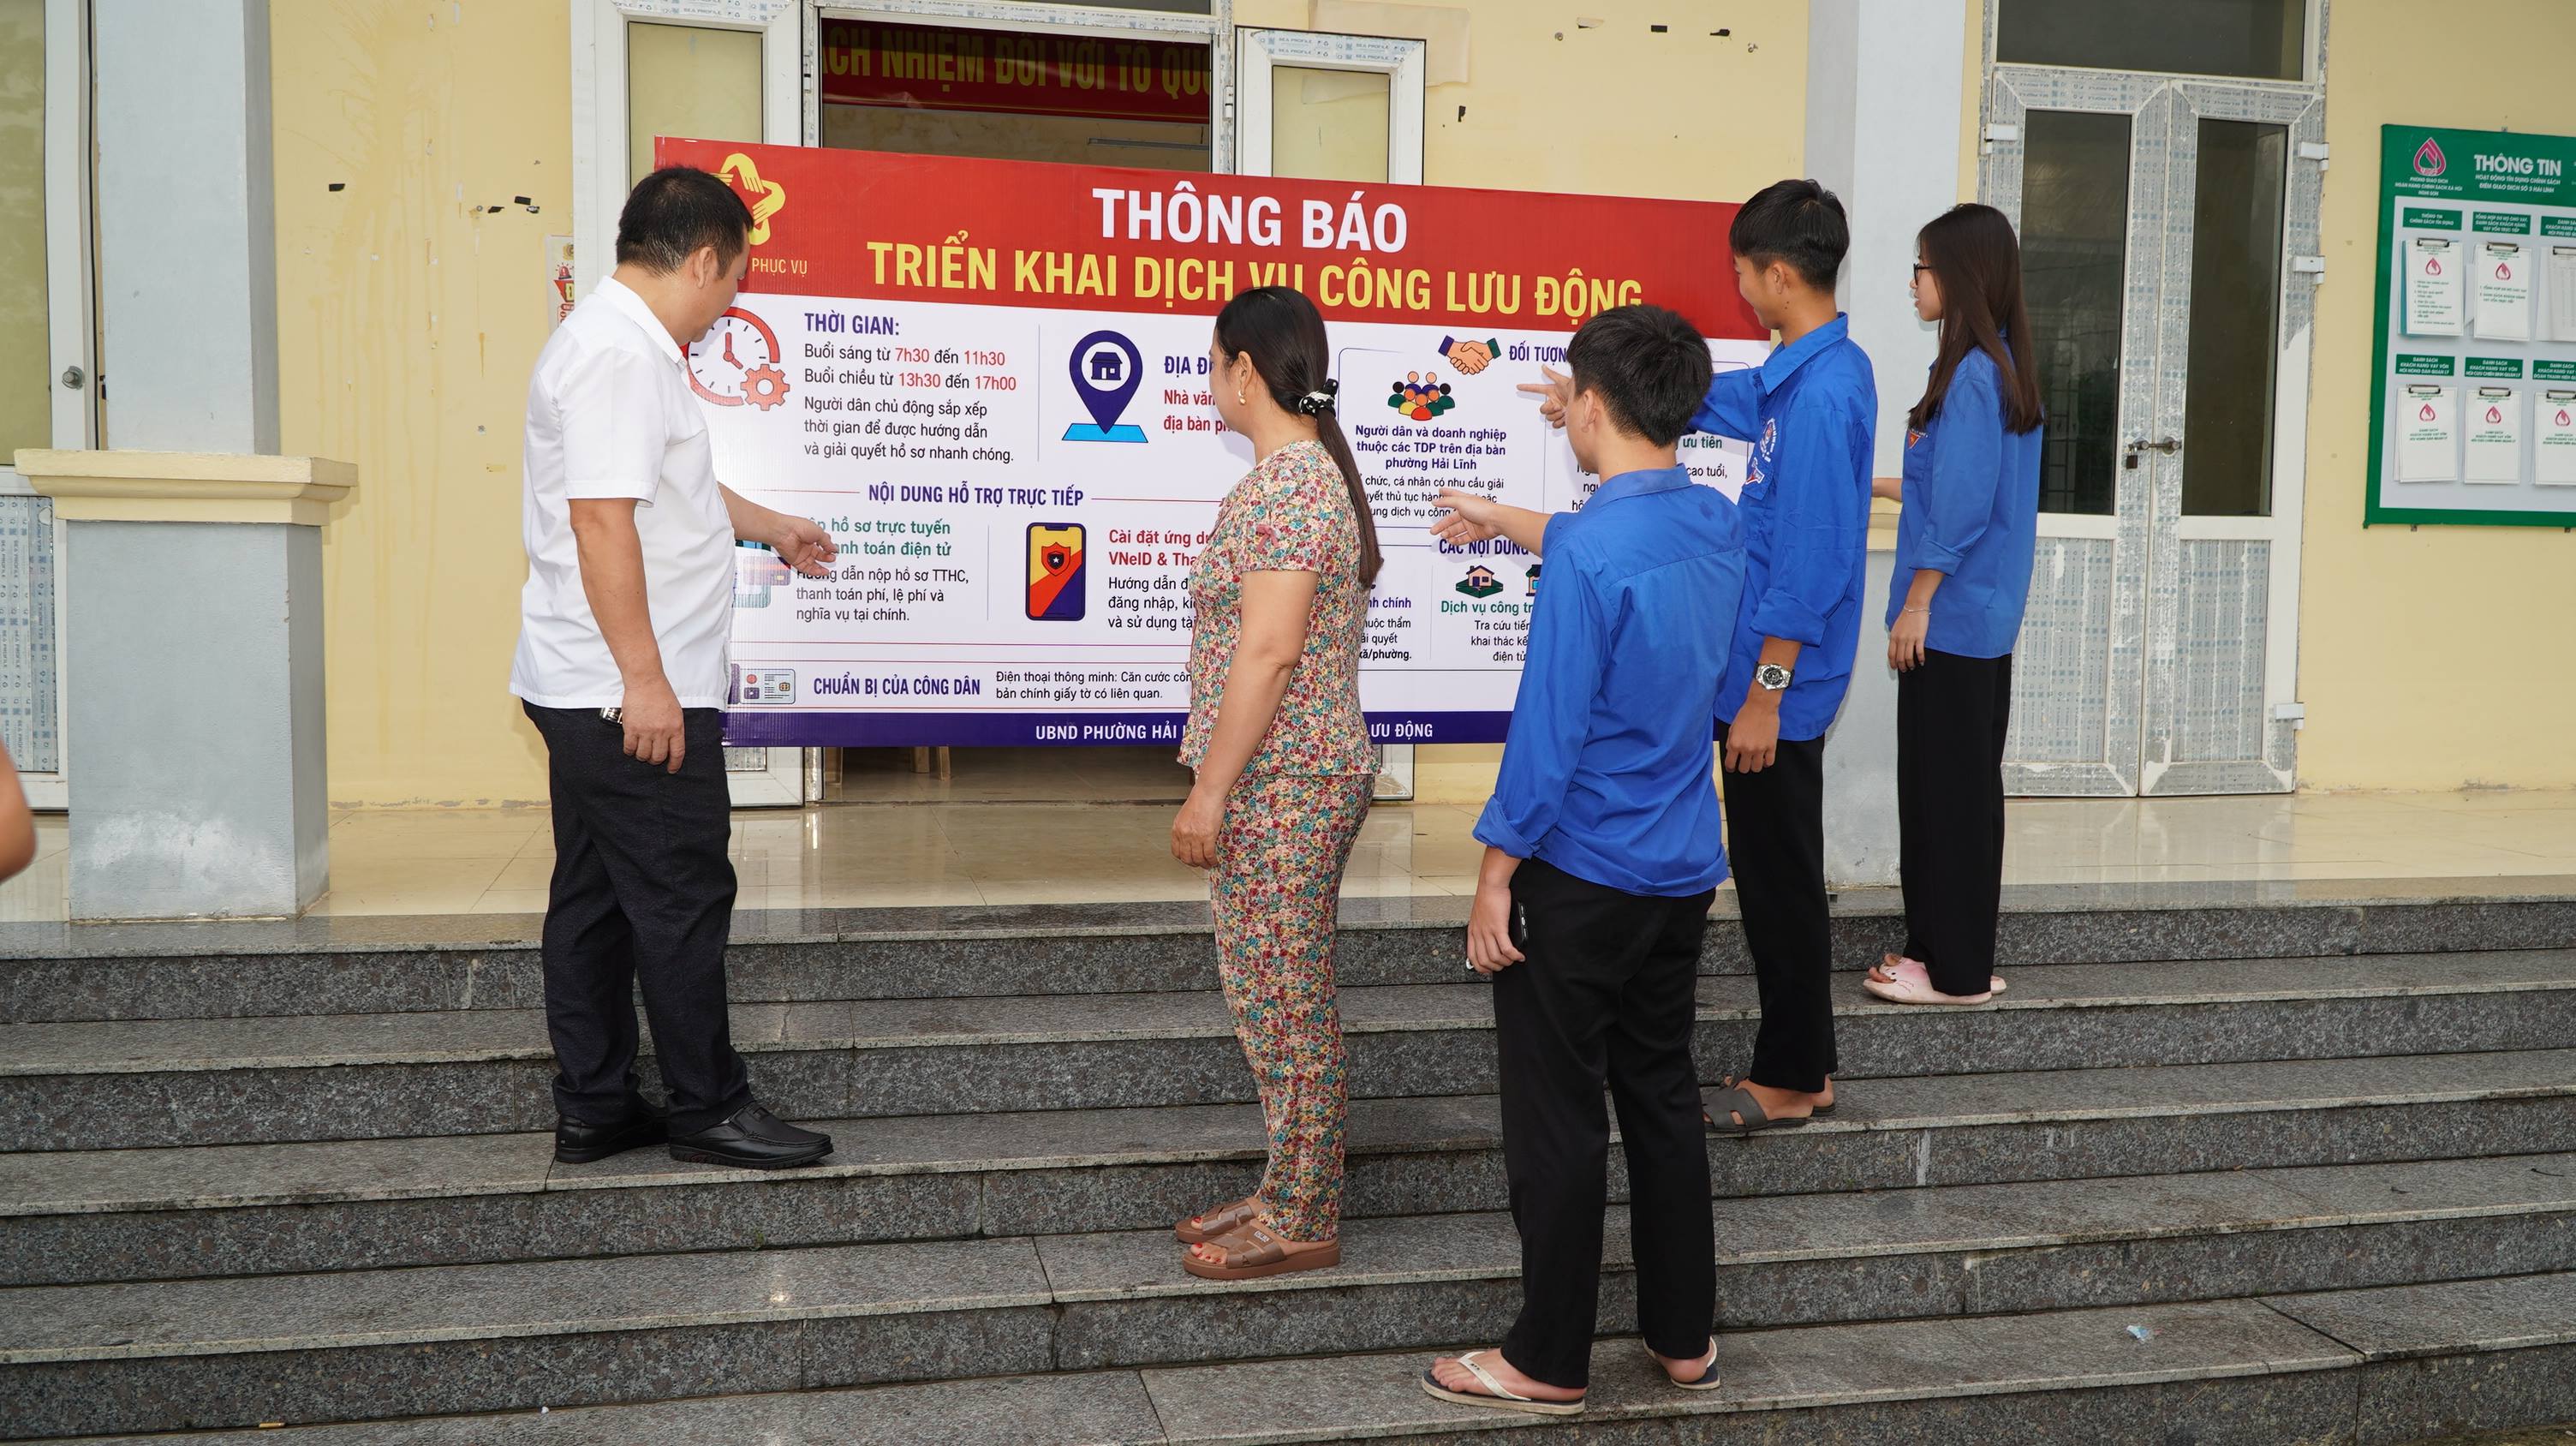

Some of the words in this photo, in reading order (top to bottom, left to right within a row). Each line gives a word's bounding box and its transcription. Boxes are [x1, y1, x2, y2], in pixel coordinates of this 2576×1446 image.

[2474, 152, 2534, 174] THÔNG
[2537, 158, 2561, 176] TIN
[1092, 180, 1282, 247] THÔNG
[1301, 191, 1408, 253] BÁO
[751, 258, 786, 275] PHỤC
[789, 260, 808, 278] VỤ
[867, 230, 996, 290] TRIỂN
[1015, 249, 1117, 296] KHAI
[1135, 257, 1234, 308] DỊCH
[1320, 257, 1431, 311] CÔNG
[1446, 271, 1521, 315] LƯU
[804, 309, 845, 333] THỜI
[852, 315, 899, 336] GIAN:
[804, 340, 835, 359] Buổi
[838, 345, 872, 363] sáng
[876, 346, 891, 361] từ
[895, 348, 930, 362] 7h30
[933, 347, 959, 364] đến
[963, 350, 1005, 366] 11h30
[1509, 340, 1530, 362] ĐỐI
[1163, 356, 1192, 378] ĐỊA
[804, 366, 835, 384] Buổi
[838, 368, 875, 385] chiều
[880, 371, 893, 385] từ
[898, 372, 941, 387] 13h30
[945, 372, 969, 389] đến
[975, 375, 1017, 391] 17h00
[1164, 390, 1189, 405] Nhà
[804, 397, 843, 414] Người
[847, 397, 871, 413] dân
[874, 398, 898, 413] chủ
[902, 399, 934, 417] động
[938, 399, 961, 419] sắp
[964, 400, 987, 419] xếp
[804, 419, 829, 433] thời
[832, 420, 861, 437] gian
[865, 418, 881, 435] để
[885, 421, 916, 439] được
[921, 421, 960, 440] hướng
[964, 420, 988, 439] dẫn
[1164, 415, 1183, 433] địa
[1187, 416, 1211, 432] bàn
[1356, 424, 1388, 439] Người
[1392, 425, 1412, 438] dân
[1416, 425, 1428, 438] và
[1432, 427, 1466, 439] doanh
[1470, 427, 1506, 442] nghiệp
[1357, 440, 1388, 455] thuộc
[1392, 440, 1410, 453] các
[1414, 442, 1436, 453] TDP
[1440, 442, 1462, 454] trên
[1465, 442, 1482, 457] địa
[1486, 444, 1506, 456] bàn
[1683, 438, 1697, 449] ưu
[1701, 436, 1722, 450] tiên
[804, 442, 820, 456] và
[823, 441, 847, 458] giải
[850, 441, 886, 460] quyết
[909, 444, 926, 458] sơ
[929, 445, 969, 460] nhanh
[972, 446, 1014, 464] chóng.
[1386, 457, 1428, 472] phường
[1432, 456, 1449, 469] Hải
[1453, 457, 1477, 470] Lĩnh
[1707, 463, 1728, 480] tuổi,
[1365, 475, 1391, 488] chức,
[1393, 476, 1404, 487] cá
[1408, 476, 1431, 487] nhân
[1447, 477, 1465, 487] nhu
[868, 481, 895, 505] NỘI
[901, 486, 943, 505] DUNG
[948, 480, 969, 505] HỖ
[975, 486, 1003, 508] TRỢ
[1008, 487, 1046, 508] TRỰC
[1052, 483, 1084, 506] TIẾP
[854, 520, 872, 534] sơ
[876, 519, 905, 536] trực
[910, 517, 951, 538] tuyến
[1109, 529, 1131, 543] Cài
[1136, 529, 1159, 547] đặt
[1164, 529, 1191, 547] ứng
[863, 541, 895, 555] toán
[900, 541, 932, 559] điện
[1108, 551, 1152, 566] VNeID
[841, 565, 864, 582] dẫn
[868, 567, 891, 584] nộp
[914, 570, 929, 582] sơ
[1108, 577, 1149, 592] Hướng
[1154, 574, 1176, 589] dẫn
[796, 588, 832, 601] thanh
[836, 588, 862, 601] toán
[908, 589, 927, 603] phí
[930, 590, 944, 602] và
[1108, 596, 1139, 612] đăng
[1382, 597, 1411, 608] chính
[796, 606, 831, 623] nghĩa
[835, 610, 850, 623] vụ
[873, 607, 909, 622] chính.
[1441, 600, 1468, 616] Dịch
[1472, 603, 1486, 616] vụ
[1491, 601, 1519, 616] công
[1108, 615, 1122, 628] và
[1127, 615, 1142, 628] sử
[1146, 616, 1177, 632] dụng
[1475, 620, 1490, 630] Tra
[1494, 619, 1512, 630] cứu
[1372, 631, 1398, 646] quyết
[1471, 636, 1491, 646] khai
[1494, 635, 1514, 646] thác
[814, 671, 859, 696] CHUẨN
[865, 678, 877, 698] BỊ
[882, 673, 909, 695] CỦA
[913, 675, 949, 696] CÔNG
[954, 675, 981, 696] DÂN
[996, 671, 1020, 684] Điện
[1024, 671, 1051, 684] thoại
[1053, 671, 1085, 684] thông
[1121, 671, 1142, 683] Căn
[1145, 671, 1170, 683] cước
[996, 687, 1017, 699] bản
[1021, 688, 1050, 699] chính
[1054, 687, 1076, 702] giấy
[1080, 688, 1091, 699] tờ
[1094, 689, 1106, 699] có
[1111, 688, 1130, 699] liên
[1035, 726, 1078, 740] UBND
[1083, 721, 1147, 740] PHƯỜNG
[1152, 720, 1178, 739] HẢI
[1394, 720, 1433, 740] ĐỘNG
